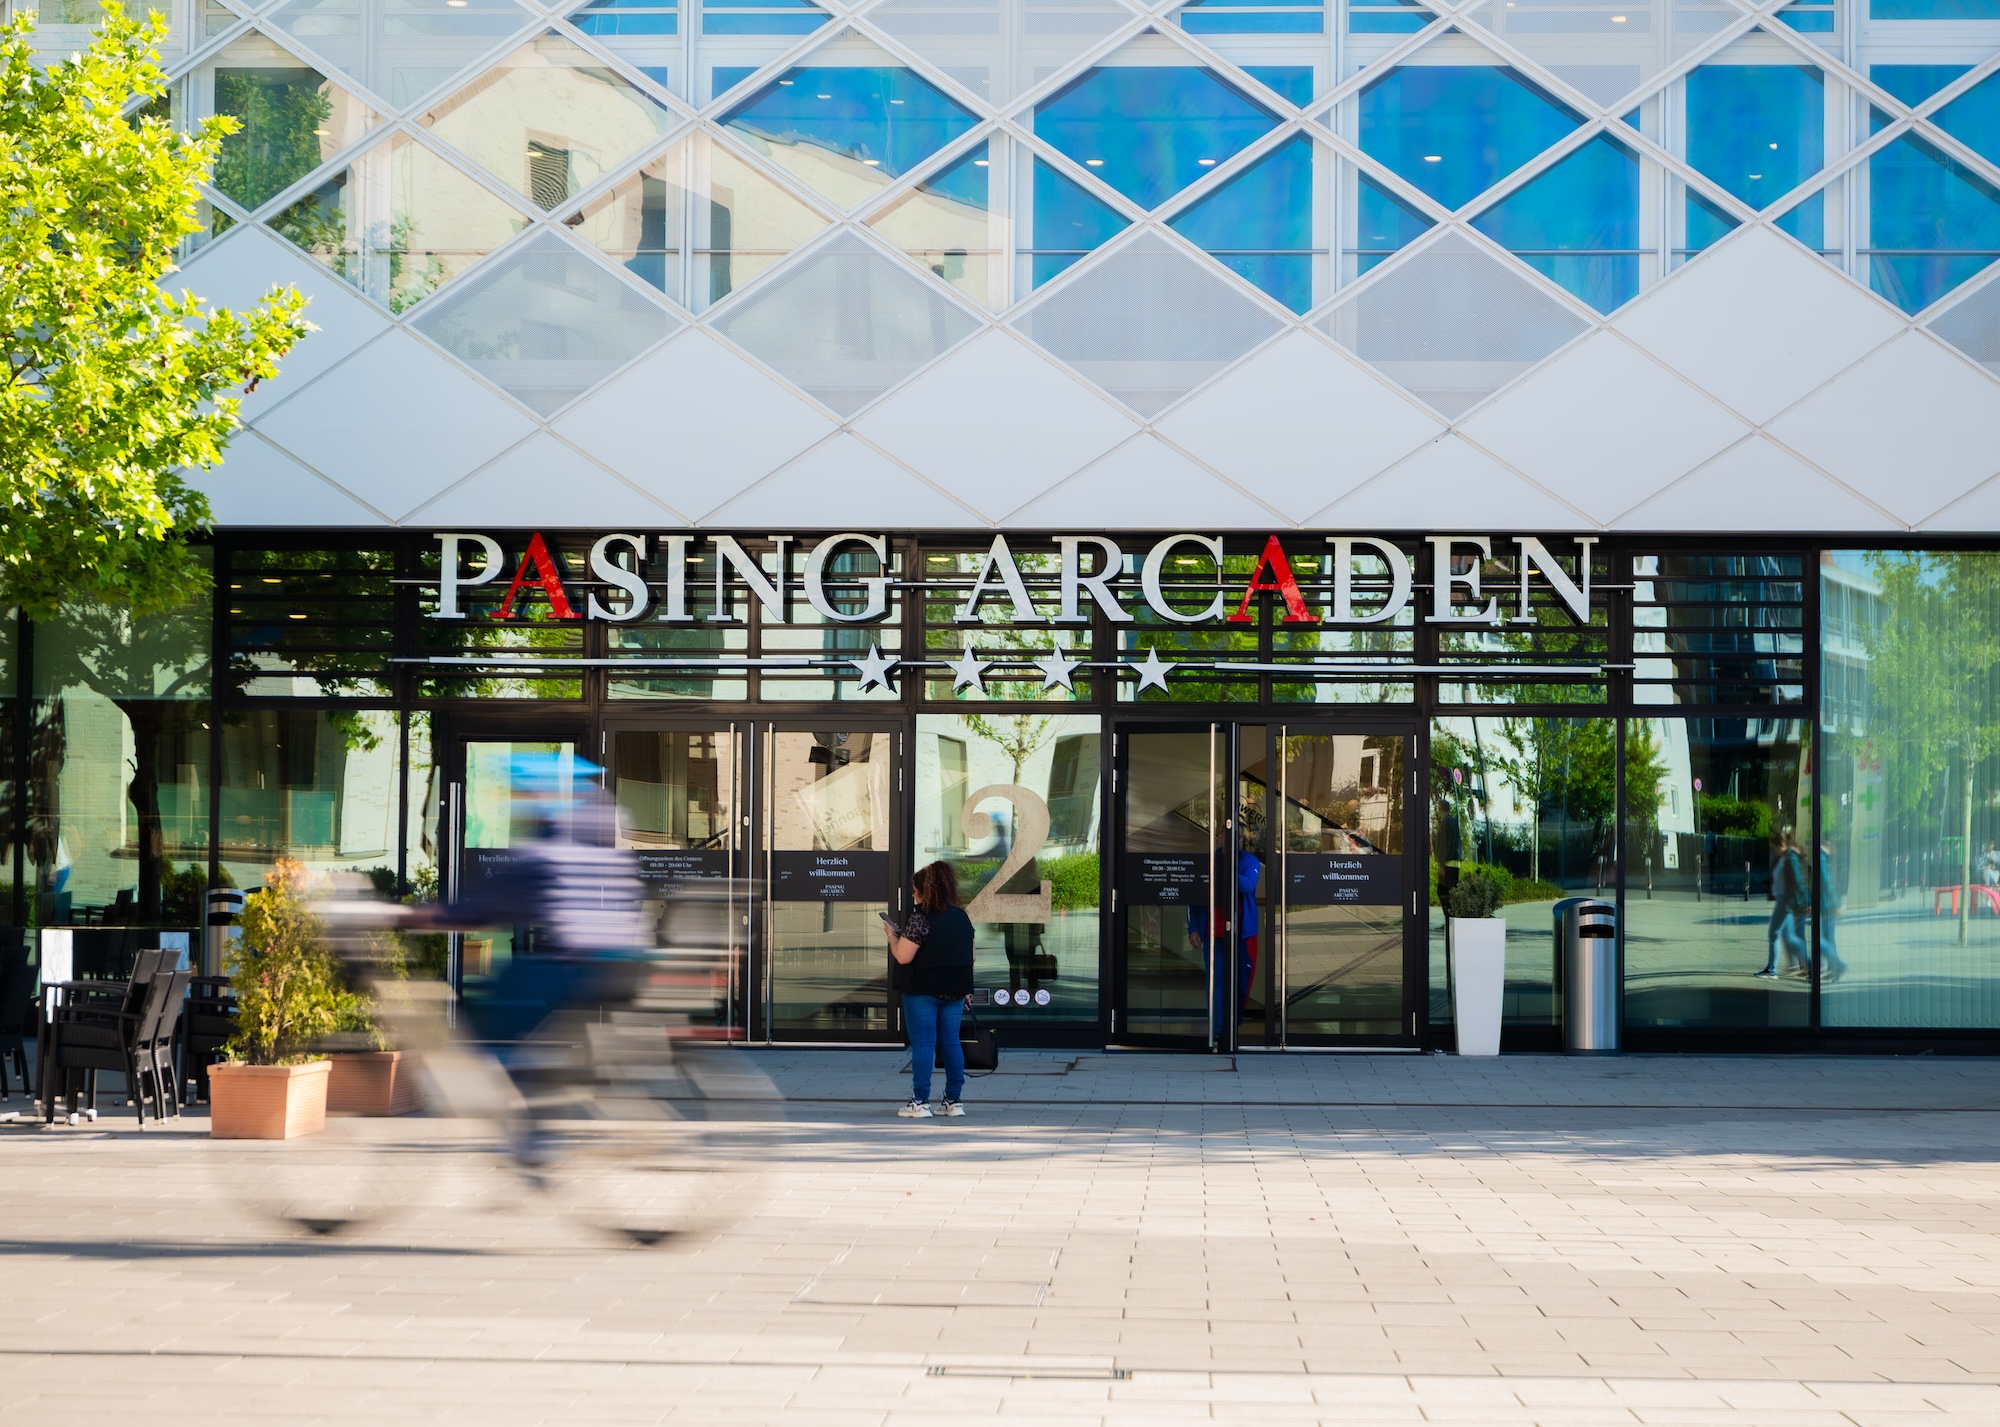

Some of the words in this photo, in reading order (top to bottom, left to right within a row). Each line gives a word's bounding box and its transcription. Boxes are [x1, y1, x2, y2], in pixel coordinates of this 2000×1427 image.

[431, 532, 894, 621] PASING
[952, 533, 1600, 624] ARCADEN
[961, 784, 1052, 923] 2
